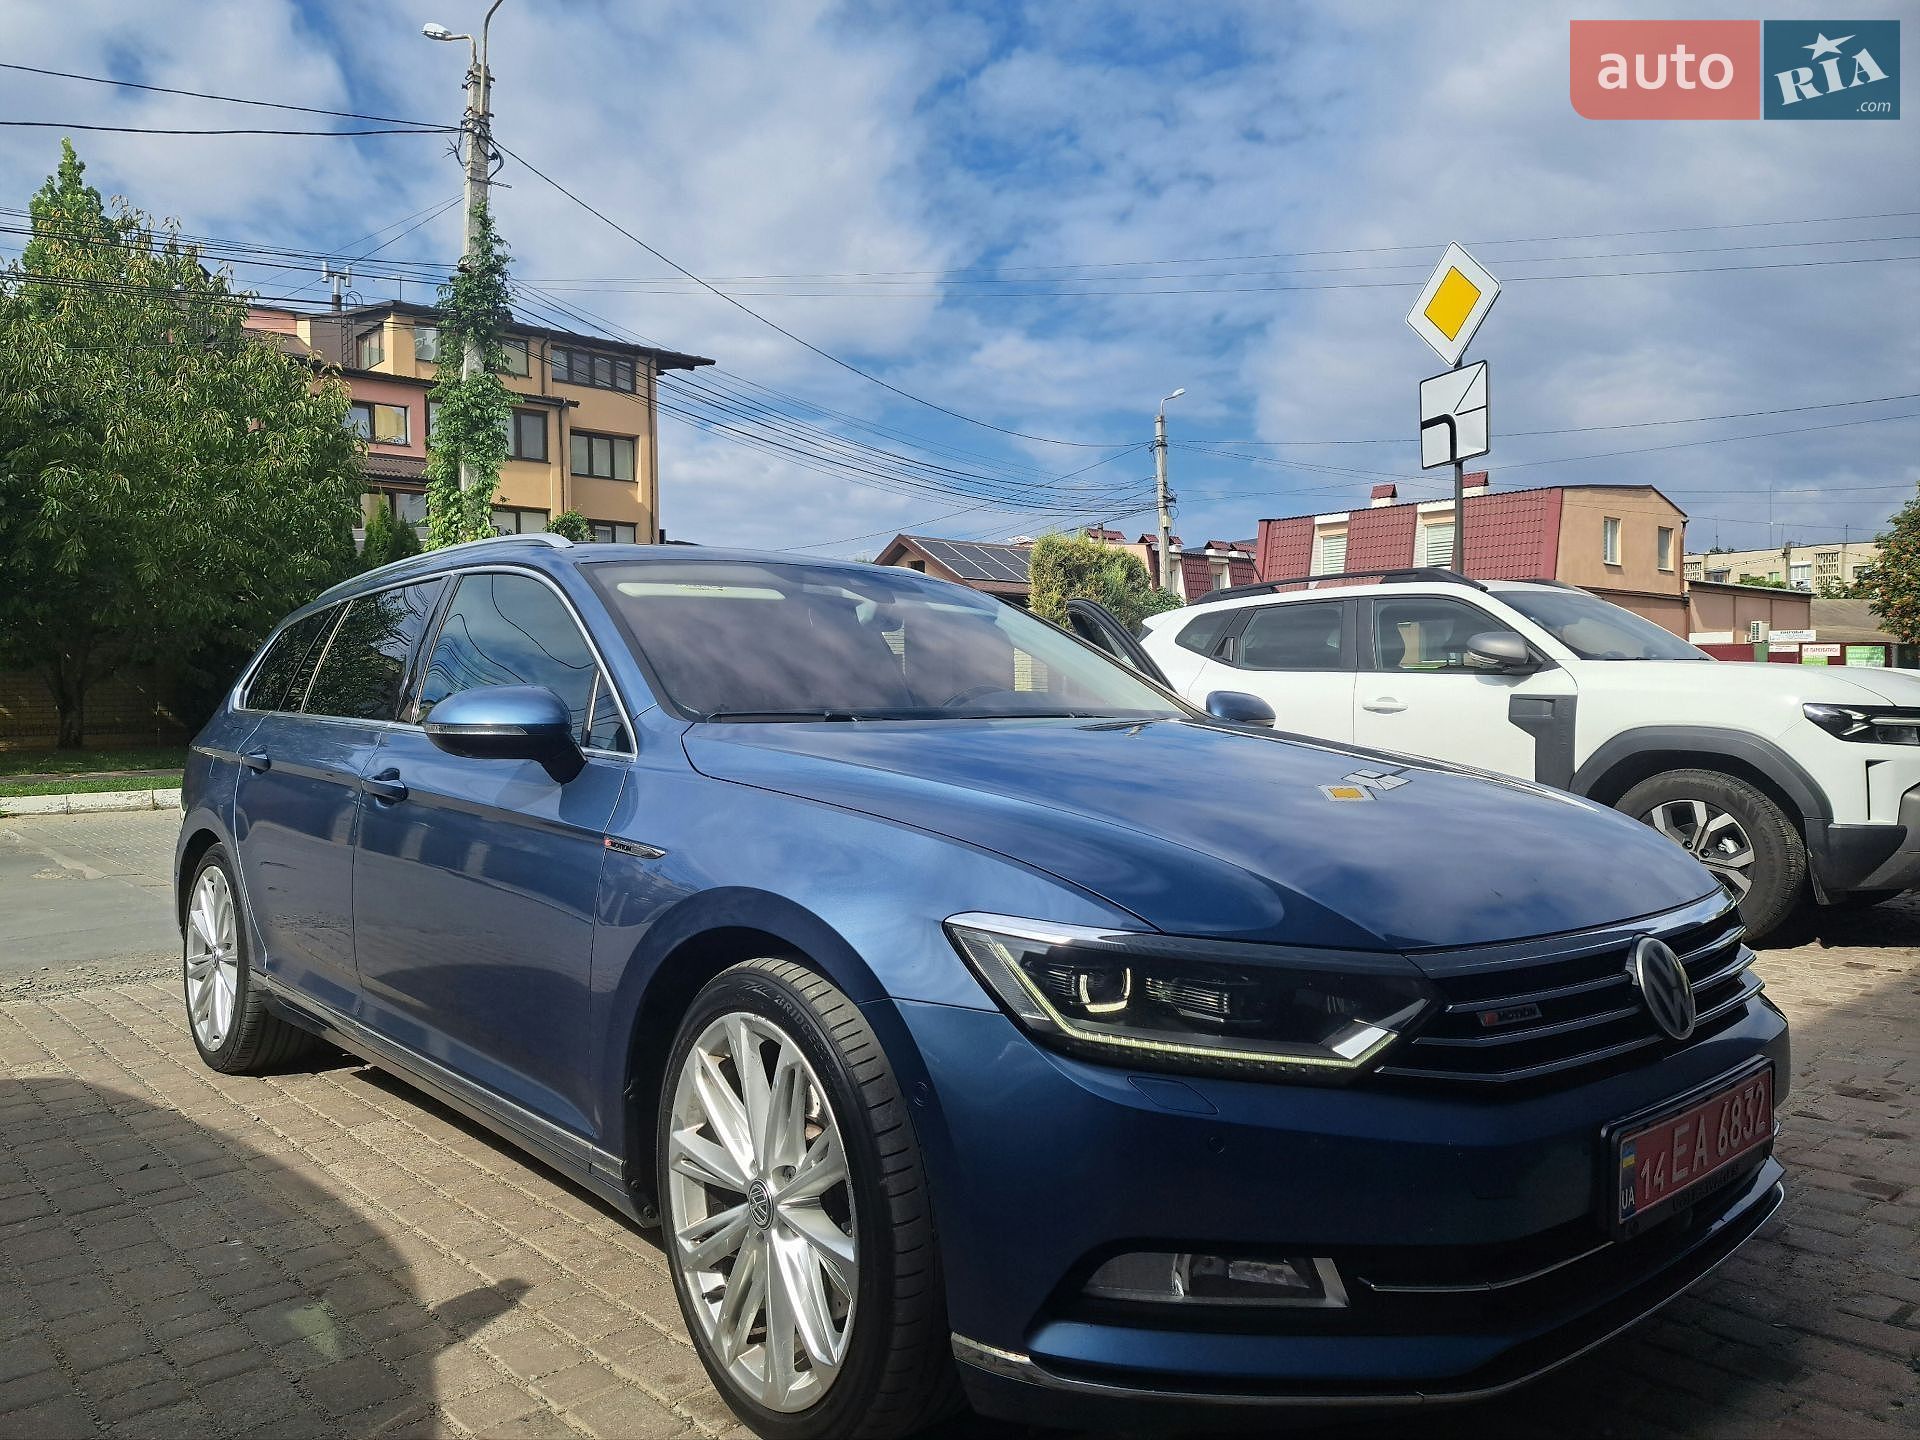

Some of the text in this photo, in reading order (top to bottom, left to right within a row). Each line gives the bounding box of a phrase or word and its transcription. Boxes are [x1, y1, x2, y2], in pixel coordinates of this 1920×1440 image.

[1641, 1152, 1666, 1200] 14
[1672, 1118, 1708, 1184] EA
[1621, 1187, 1635, 1209] UA
